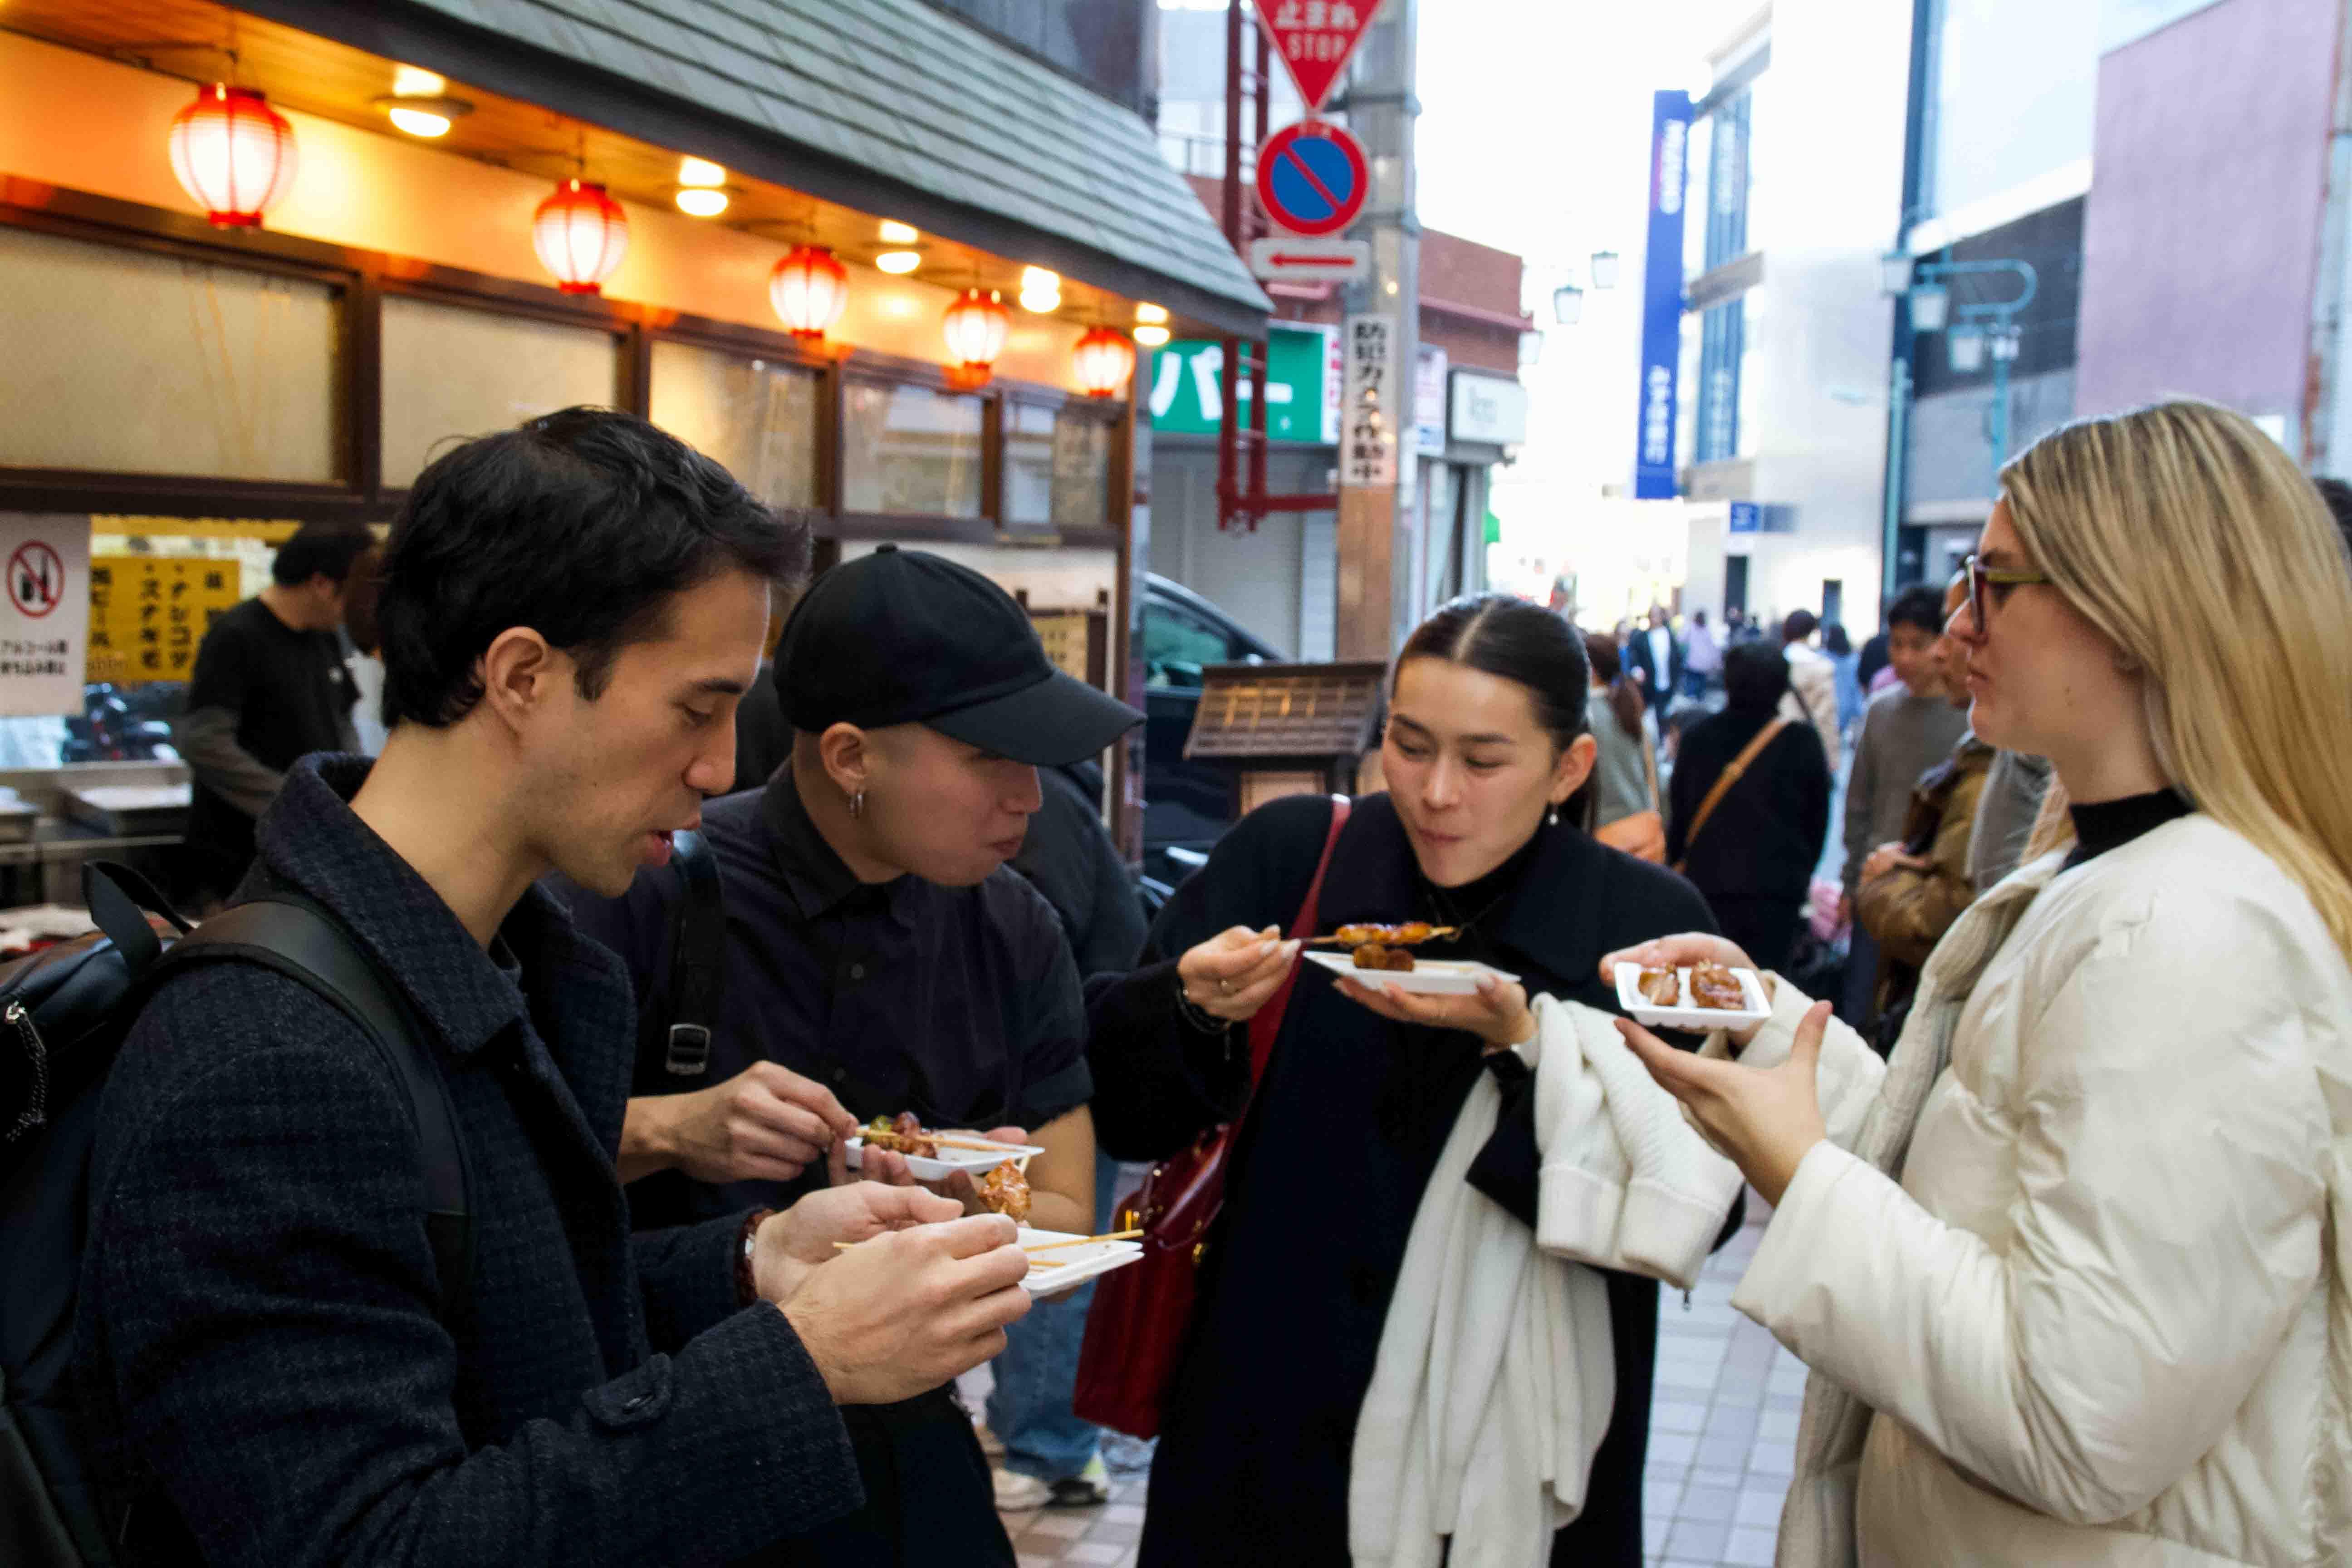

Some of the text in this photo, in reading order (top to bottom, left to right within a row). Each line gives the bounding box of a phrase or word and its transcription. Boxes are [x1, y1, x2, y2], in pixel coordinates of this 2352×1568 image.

[1275, 0, 1358, 29] 止まれ
[1287, 34, 1347, 62] STOP
